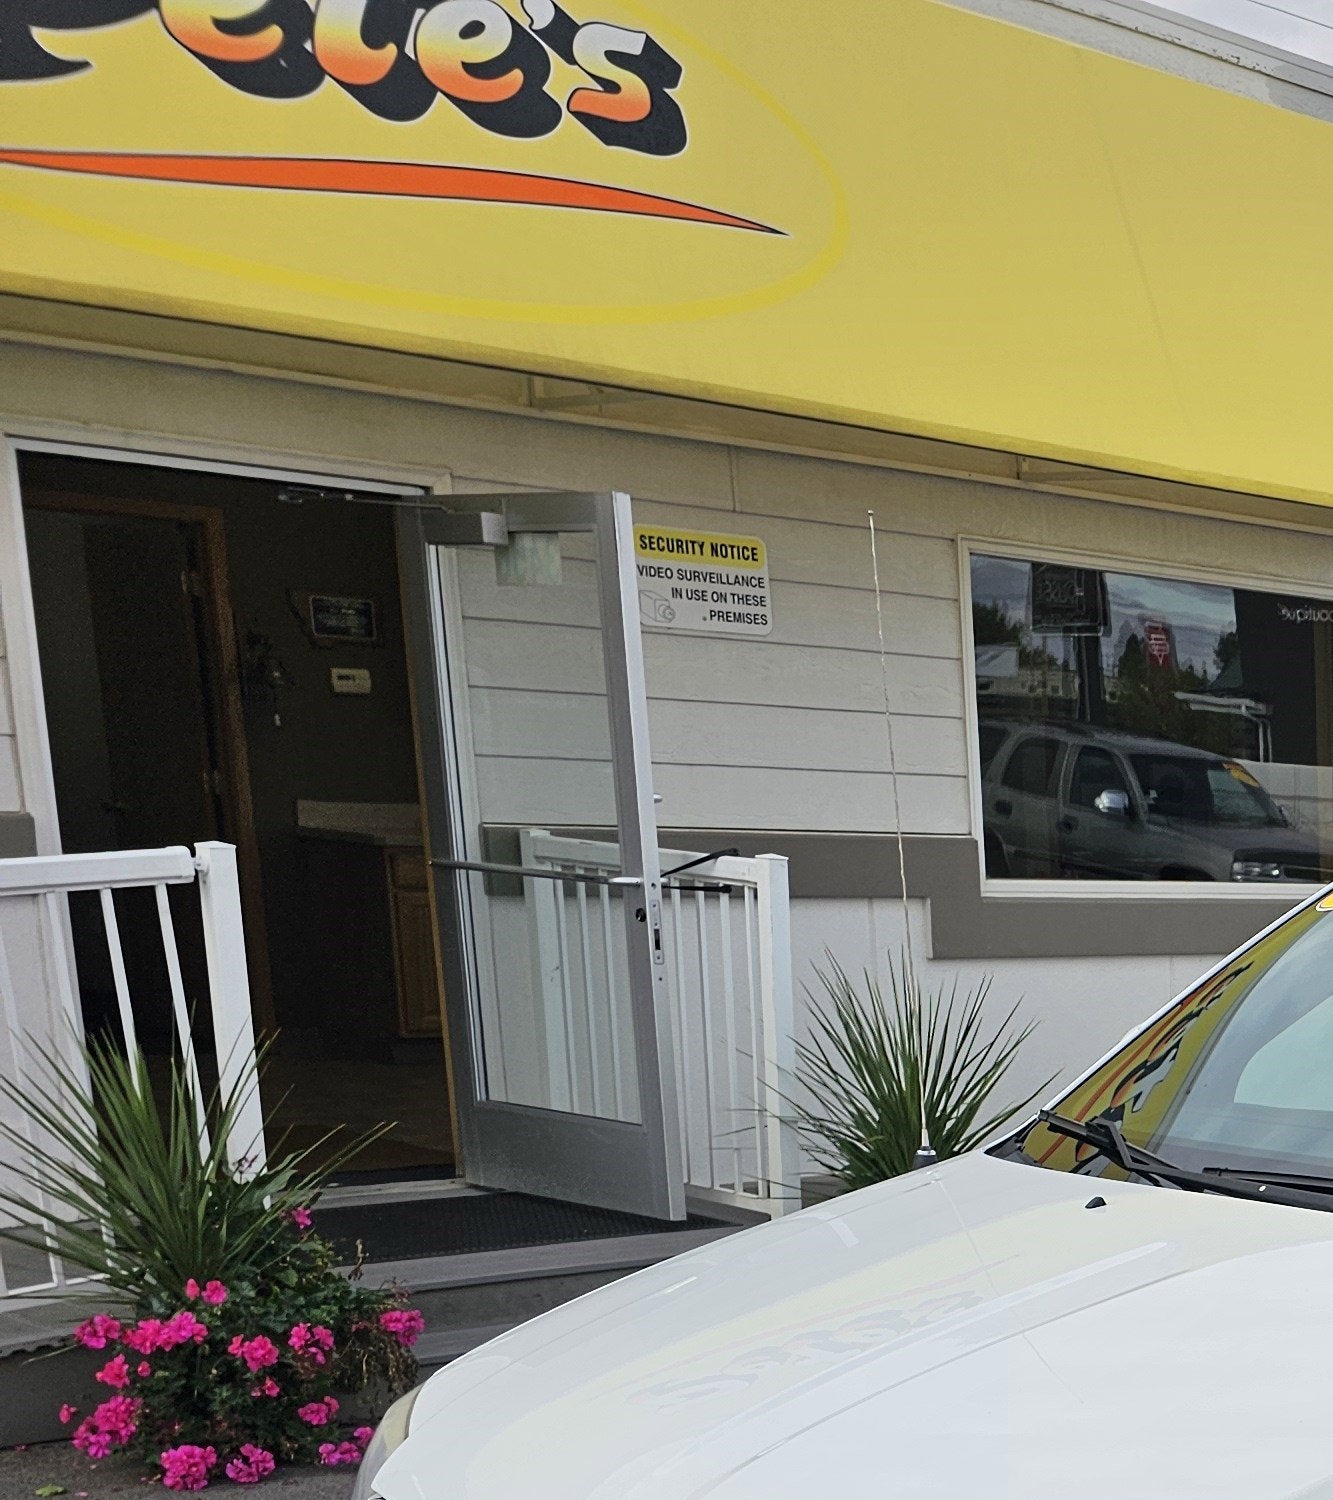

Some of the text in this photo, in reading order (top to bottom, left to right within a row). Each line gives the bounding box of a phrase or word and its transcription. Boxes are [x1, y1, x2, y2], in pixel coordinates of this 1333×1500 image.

[639, 534, 759, 562] SECURITY NOTICE
[637, 564, 765, 589] VIDEO SURVEILLANCE
[671, 587, 767, 607] IN USE ON THESE
[709, 609, 768, 626] PREMISES
